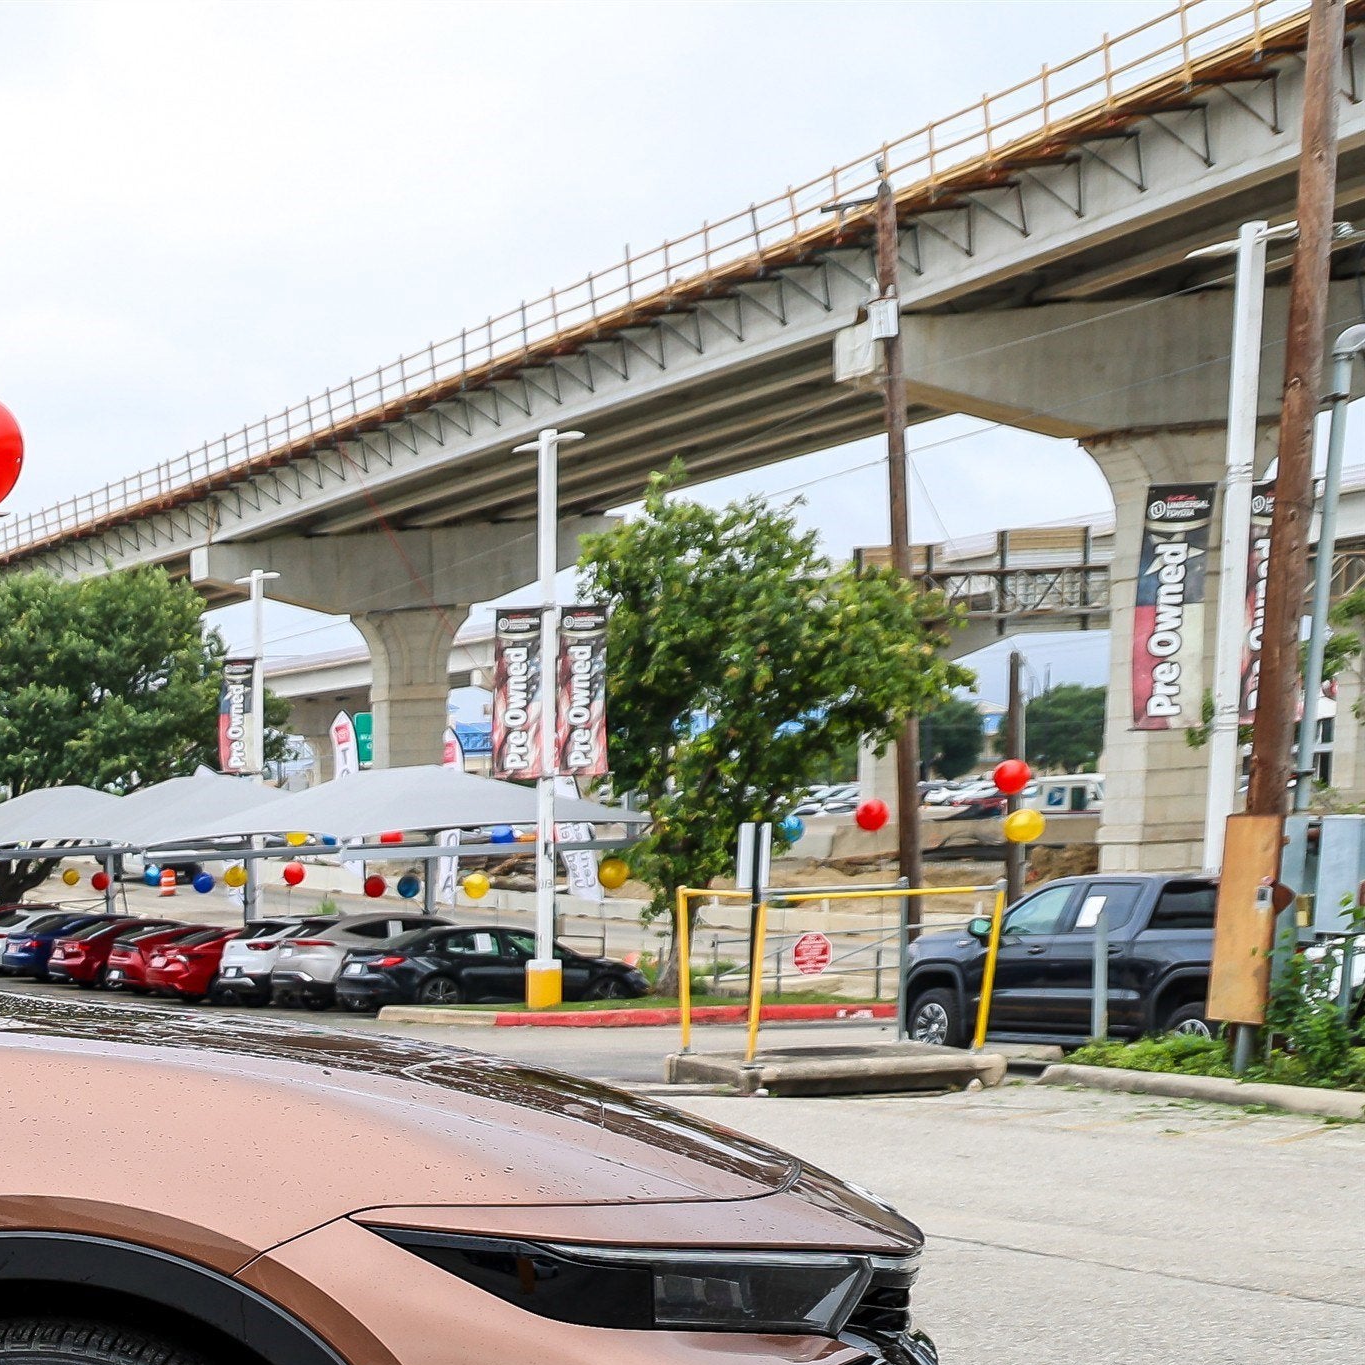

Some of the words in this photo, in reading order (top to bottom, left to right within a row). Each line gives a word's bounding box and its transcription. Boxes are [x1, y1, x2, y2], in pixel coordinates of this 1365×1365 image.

[1147, 542, 1189, 657] Owned
[227, 684, 245, 740] Owned
[502, 646, 529, 728] Owned
[567, 645, 593, 725] Owned
[1146, 659, 1182, 717] Pre
[228, 740, 246, 768] Pre
[503, 729, 529, 770] Pre
[567, 727, 593, 768] Pre
